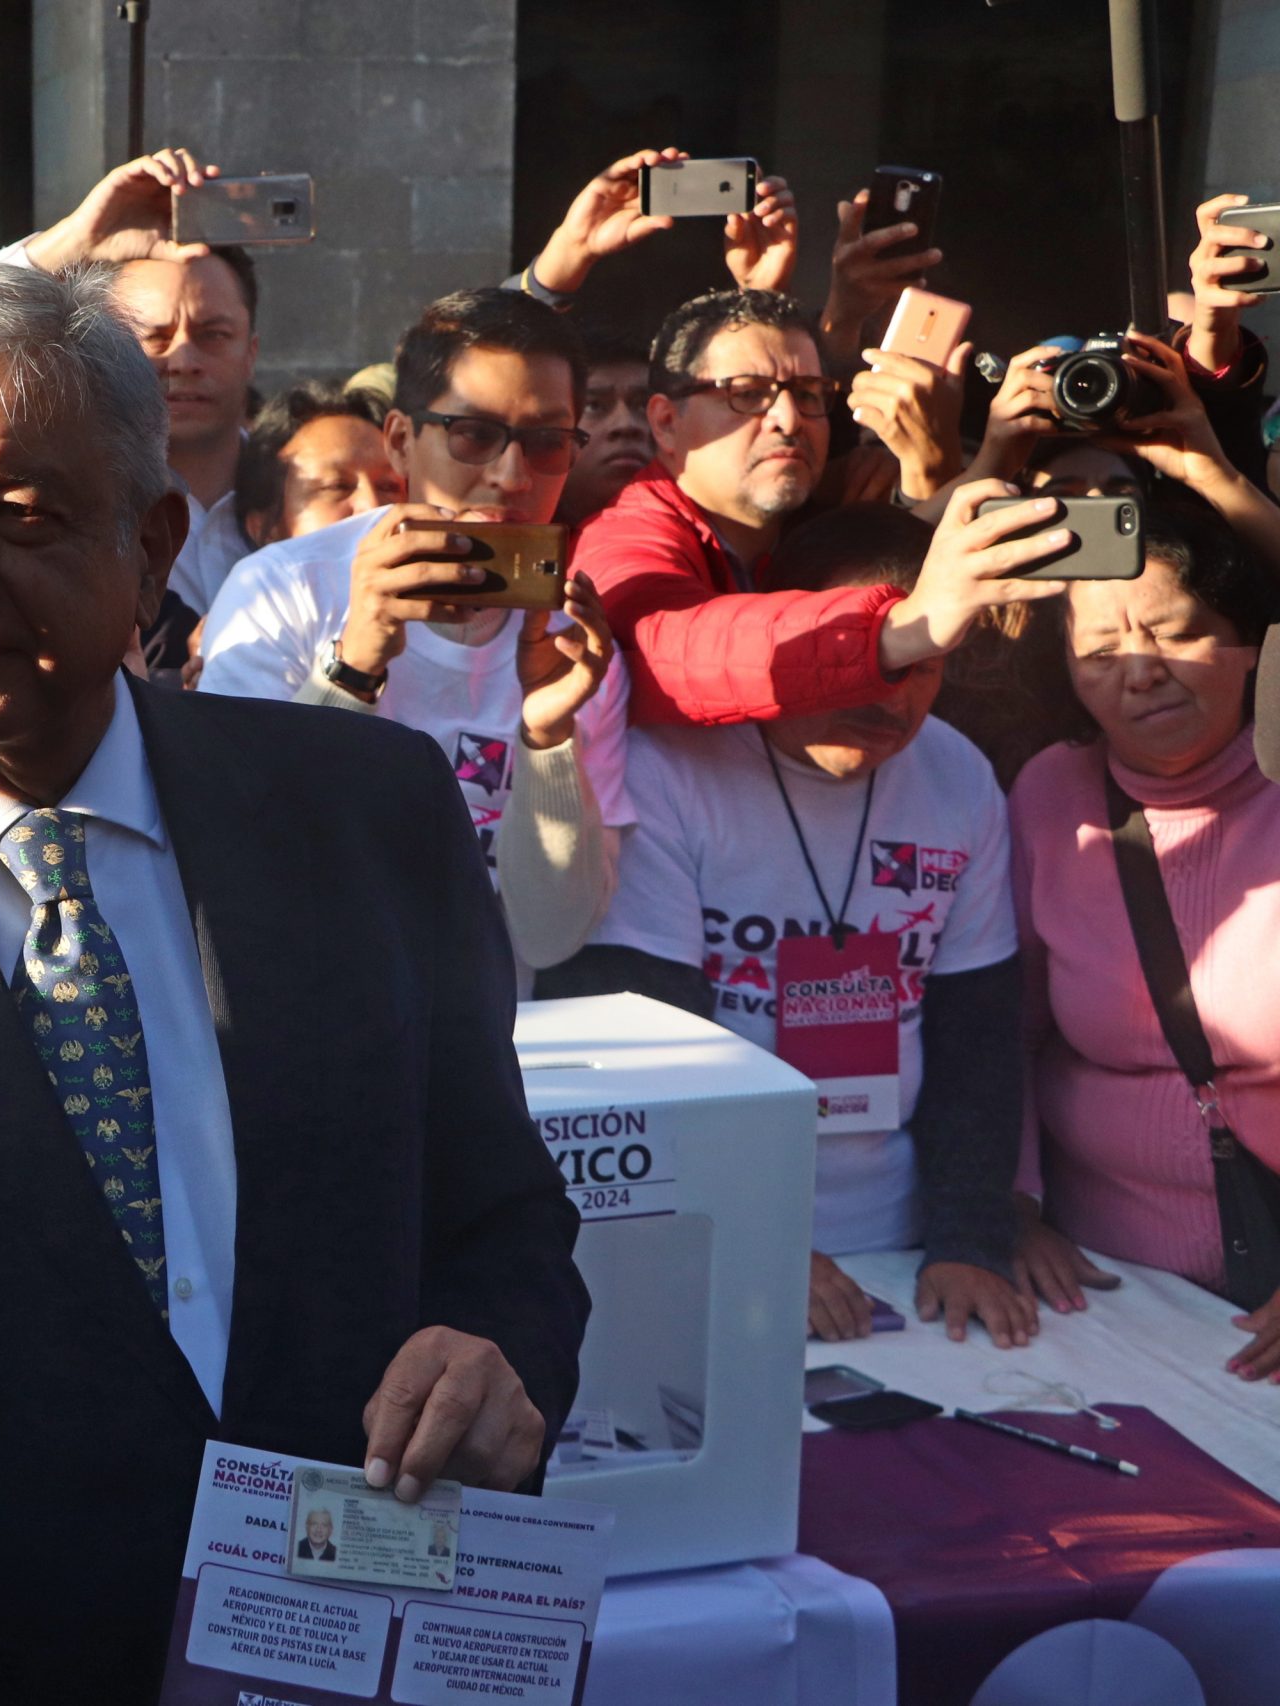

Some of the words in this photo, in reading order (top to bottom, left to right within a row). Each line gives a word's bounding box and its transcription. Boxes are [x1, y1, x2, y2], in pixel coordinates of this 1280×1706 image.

[1090, 340, 1119, 349] Nikon
[785, 975, 894, 998] CONSULTA
[785, 996, 894, 1015] NACIONAL
[536, 1106, 646, 1142] SICIÓN
[582, 1188, 631, 1210] 2024
[212, 1481, 240, 1492] NUEVO
[242, 1488, 290, 1501] AEROPUERT
[246, 1514, 278, 1531] DADA
[280, 1522, 289, 1533] L
[460, 1507, 471, 1516] LA
[472, 1509, 503, 1521] OPCIÓN
[504, 1514, 521, 1524] QUE
[522, 1516, 542, 1526] CREA
[543, 1518, 595, 1532] CONVENIENTE
[208, 1541, 249, 1559] ¿CUÁL
[476, 1554, 563, 1576] INTERNACIONAL
[229, 1585, 308, 1611] REACONDICIONAR
[310, 1602, 321, 1613] EL
[323, 1604, 358, 1619] ACTUAL
[456, 1585, 499, 1601] MEJOR
[500, 1591, 535, 1605] PARA
[536, 1595, 551, 1607] EL
[553, 1595, 586, 1611] PAÍS?
[222, 1598, 283, 1619] AEROPUERTO
[284, 1611, 297, 1622] DE
[299, 1613, 310, 1624] LA
[312, 1616, 347, 1631] CIUDAD
[348, 1622, 361, 1634] DE
[231, 1612, 266, 1629] MÉXICO
[268, 1621, 275, 1631] Y
[276, 1622, 287, 1634] EL
[289, 1625, 302, 1637] DE
[304, 1627, 339, 1643] TOLUCA
[341, 1634, 348, 1645] Y
[207, 1622, 259, 1642] CONSTRUIR
[261, 1633, 279, 1646] DOS
[280, 1637, 313, 1652] PISTAS
[314, 1643, 328, 1655] EN
[328, 1645, 341, 1657] LA
[342, 1649, 367, 1662] BASE
[422, 1621, 472, 1637] CONTINUAR
[473, 1628, 491, 1639] CON
[492, 1630, 503, 1641] LA
[504, 1632, 567, 1648] CONSTRUCCIÓN
[231, 1640, 261, 1657] AÉREA
[263, 1648, 276, 1660] DE
[277, 1650, 307, 1665] SANTA
[309, 1656, 337, 1671] LUCÍA.
[414, 1633, 431, 1645] DEL
[432, 1636, 462, 1649] NUEVO
[463, 1641, 519, 1657] AEROPUERTO
[520, 1647, 532, 1658] EN
[533, 1648, 570, 1662] TEXCOCO
[431, 1649, 438, 1659] Y
[439, 1650, 468, 1664] DEJAR
[468, 1655, 480, 1665] DE
[481, 1656, 505, 1668] USAR
[506, 1659, 516, 1669] EL
[517, 1661, 549, 1673] ACTUAL
[413, 1661, 470, 1678] AEROPUERTO
[470, 1666, 537, 1686] INTERNACIONAL
[538, 1675, 550, 1687] DE
[550, 1676, 561, 1688] LA
[446, 1679, 478, 1693] CIUDAD
[479, 1683, 491, 1694] DE
[492, 1682, 525, 1698] MÉXICO.
